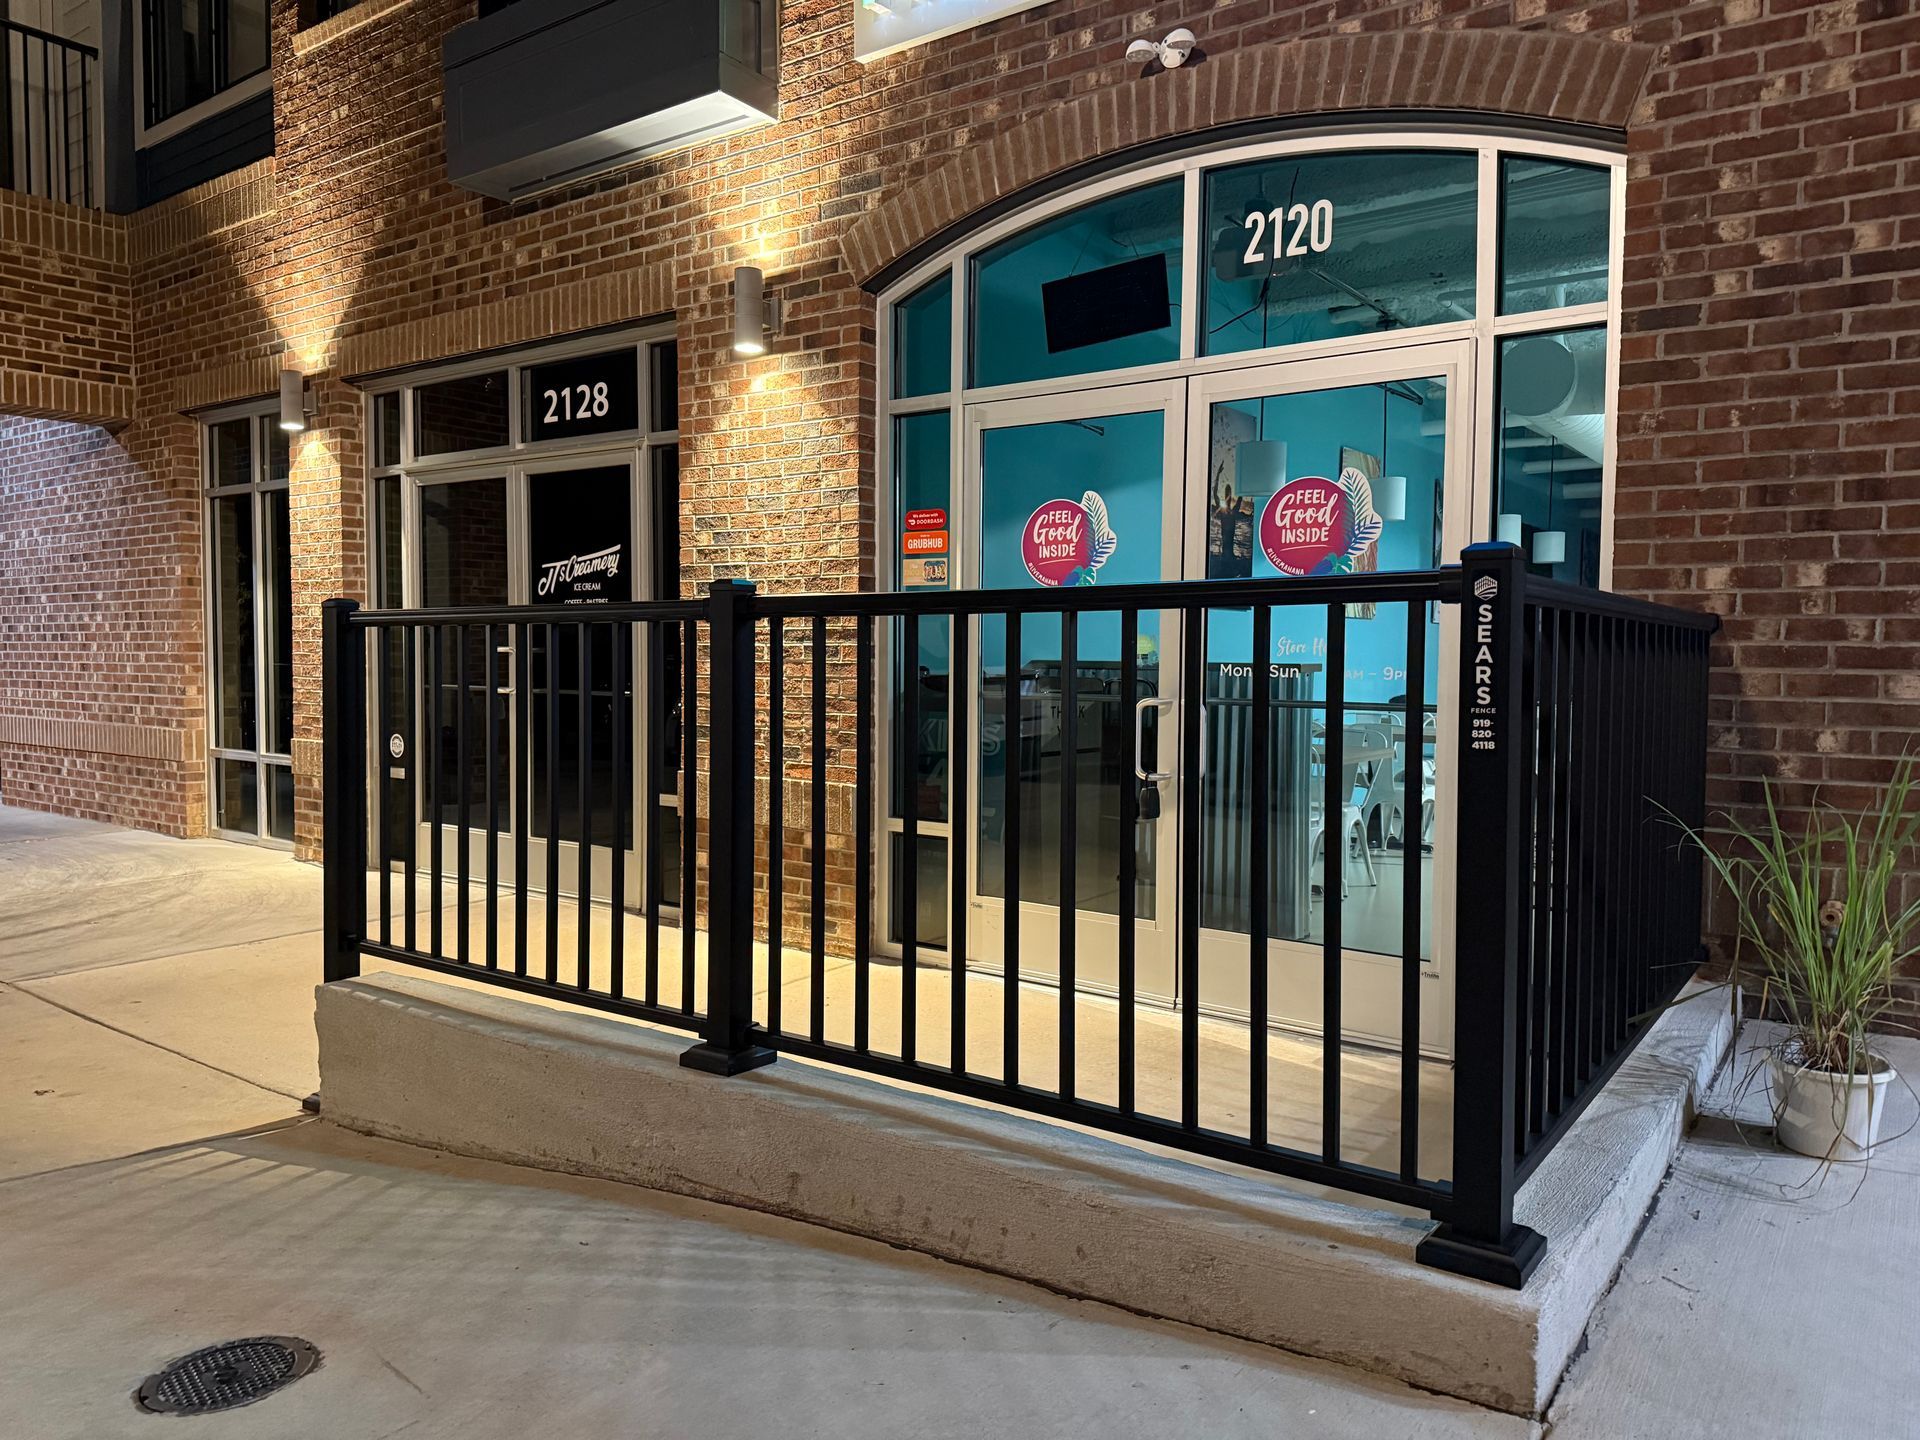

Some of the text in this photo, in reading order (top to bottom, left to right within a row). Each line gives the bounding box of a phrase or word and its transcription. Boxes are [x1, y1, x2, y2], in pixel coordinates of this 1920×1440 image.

[1243, 199, 1333, 264] 2120
[543, 381, 609, 424] 2128
[1296, 488, 1327, 504] FEEL
[1049, 510, 1073, 524] FEEL
[1275, 492, 1339, 528] Good
[1033, 513, 1082, 544] Good
[1281, 526, 1329, 544] INSIDE
[907, 538, 943, 549] GRUBHUB
[1039, 545, 1076, 559] INSIDE
[565, 544, 621, 582] Creamery
[574, 582, 601, 591] ICE CREAM
[1277, 636, 1307, 657] Store
[1475, 604, 1494, 705] SEARS
[1219, 663, 1252, 677] Mon
[1269, 664, 1299, 678] Sun
[1472, 719, 1494, 727] 919-
[1471, 730, 1496, 738] 820-
[1471, 741, 1496, 750] 4118
